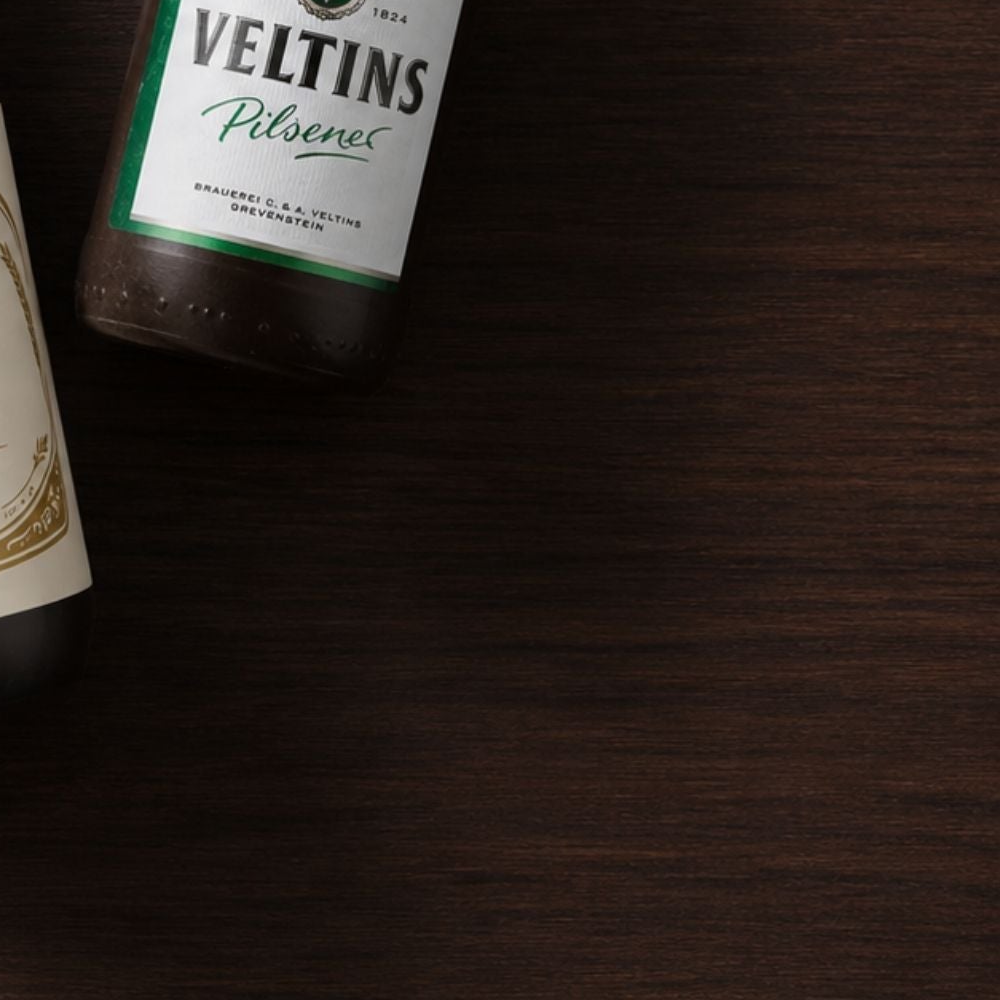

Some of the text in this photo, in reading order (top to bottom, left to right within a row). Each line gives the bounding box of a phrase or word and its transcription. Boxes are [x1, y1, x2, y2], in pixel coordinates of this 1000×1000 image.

[372, 6, 408, 25] 1824
[193, 7, 430, 116] VELTINS
[200, 96, 393, 152] Pilsener
[294, 205, 306, 217] A.
[311, 208, 362, 230] VELTINS
